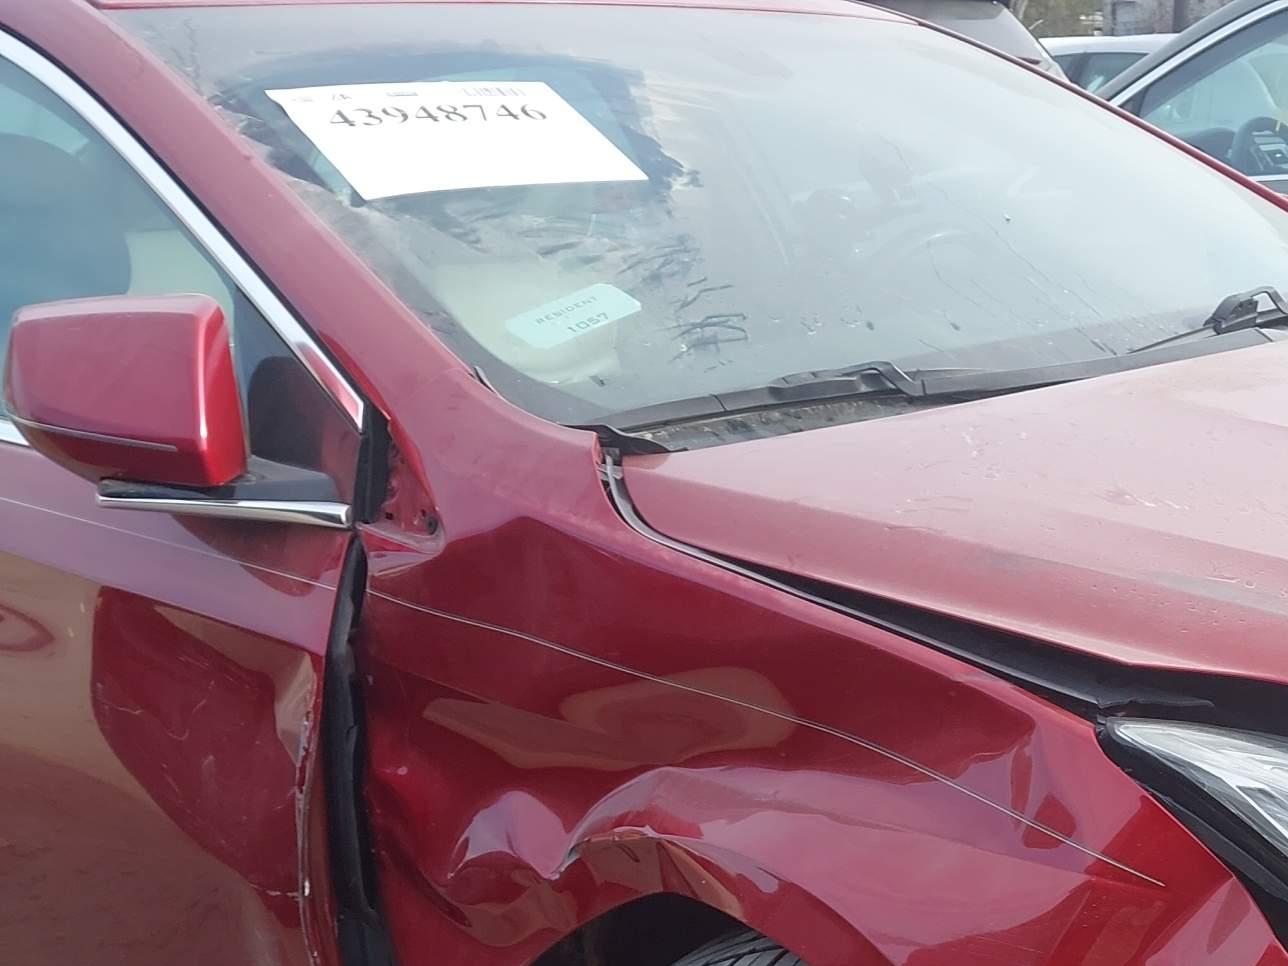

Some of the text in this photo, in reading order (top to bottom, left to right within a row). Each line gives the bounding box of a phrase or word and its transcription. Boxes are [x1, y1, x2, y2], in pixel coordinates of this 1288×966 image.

[329, 103, 547, 127] 43948746
[534, 295, 599, 325] RESIDENT
[567, 311, 609, 333] 1057
